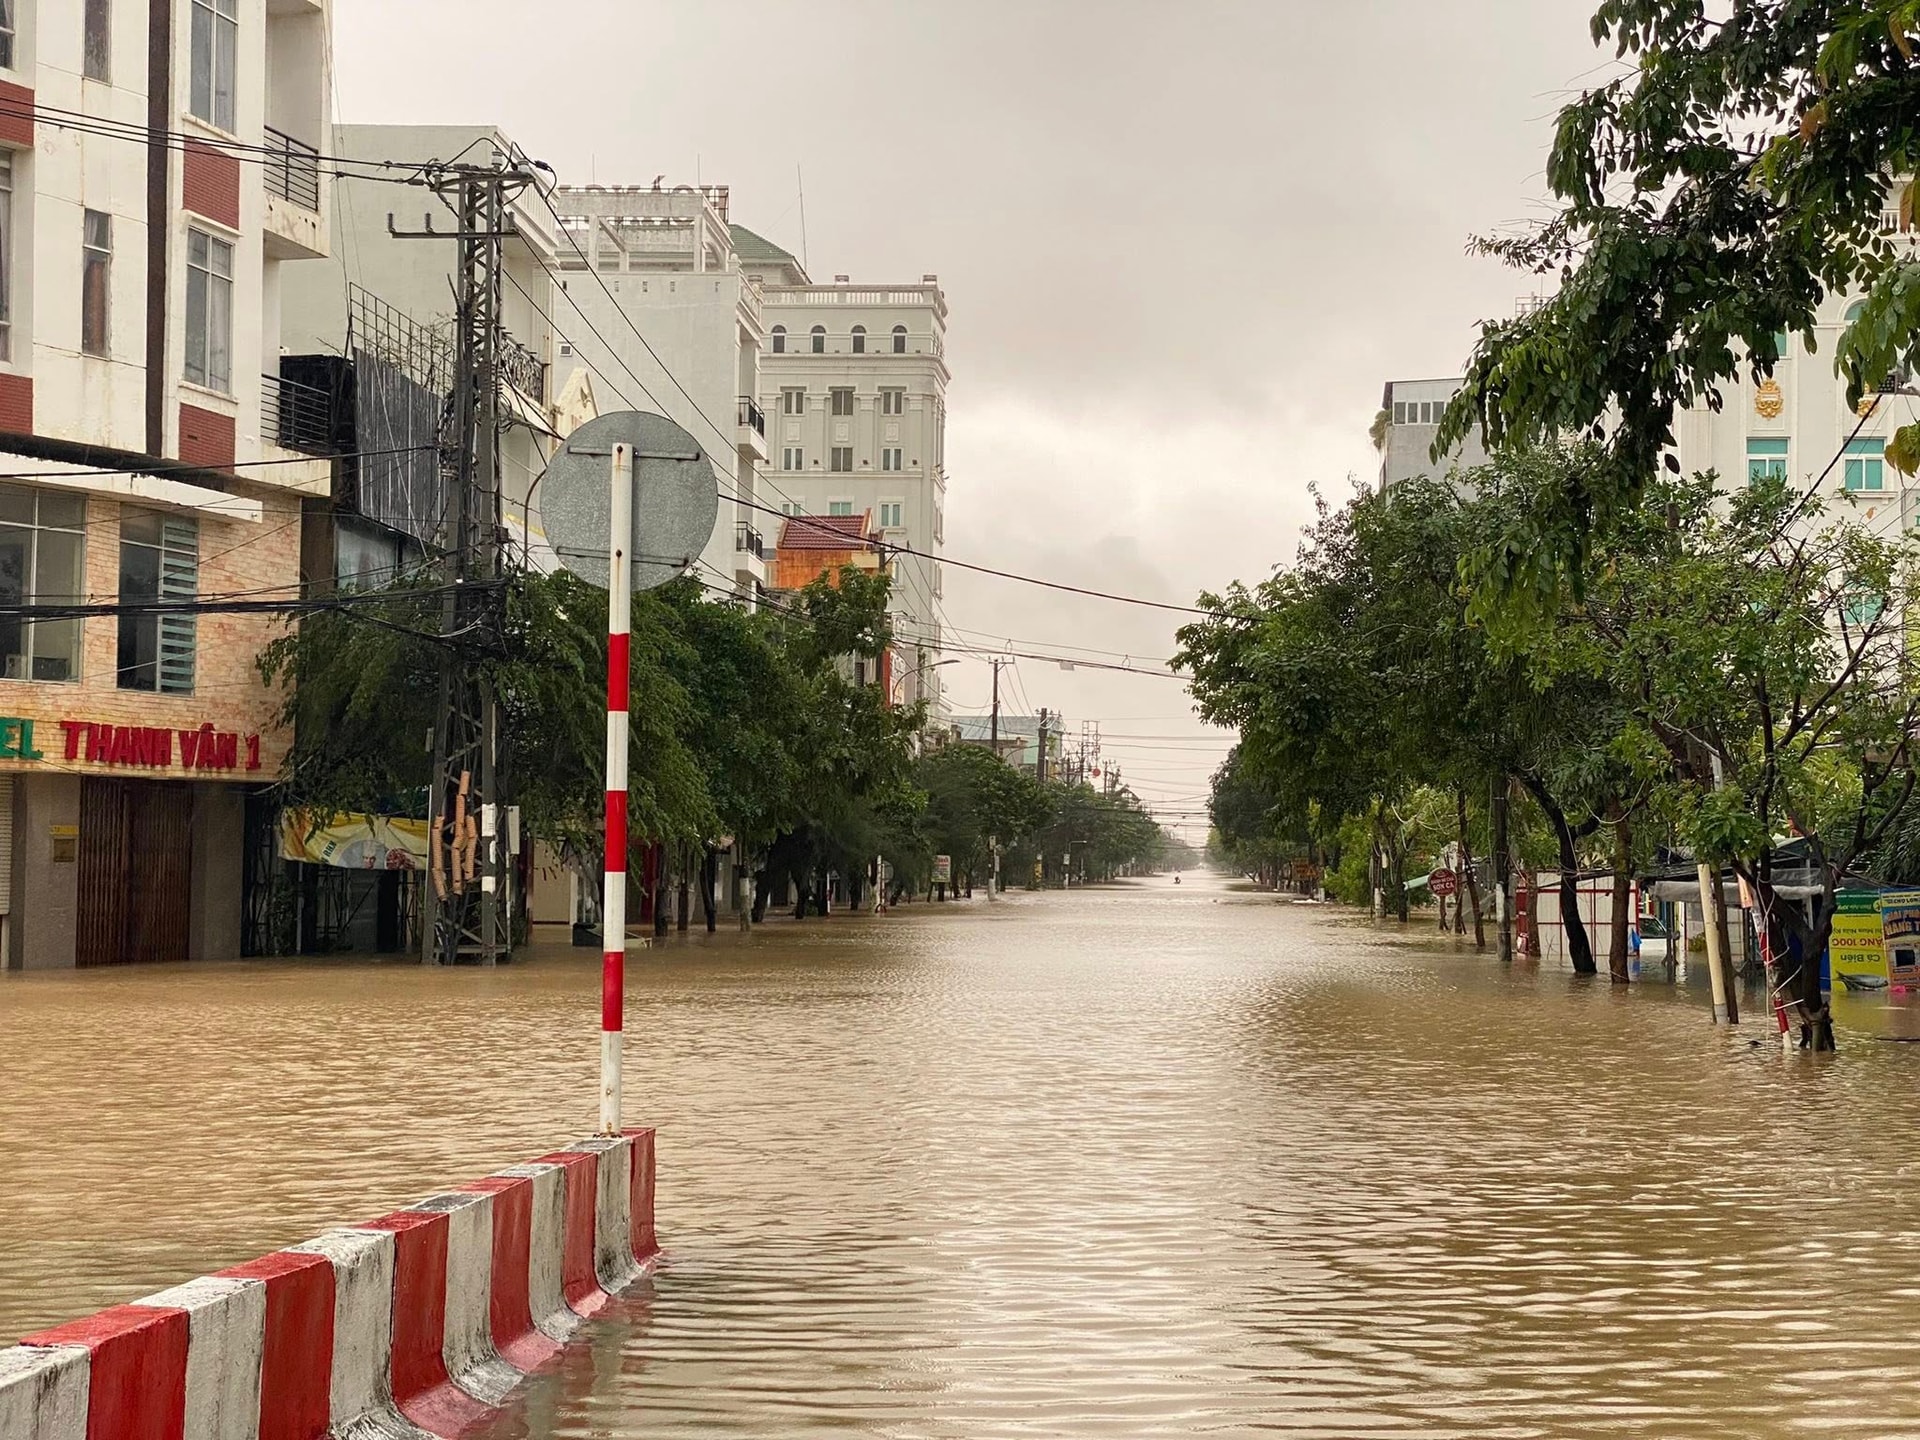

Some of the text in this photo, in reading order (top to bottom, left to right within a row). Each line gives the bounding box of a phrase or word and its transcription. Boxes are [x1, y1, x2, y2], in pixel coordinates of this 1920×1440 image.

[60, 720, 172, 767] THANH
[178, 722, 238, 770] VÂN
[244, 733, 262, 771] 1
[1832, 938, 1857, 947] 100G
